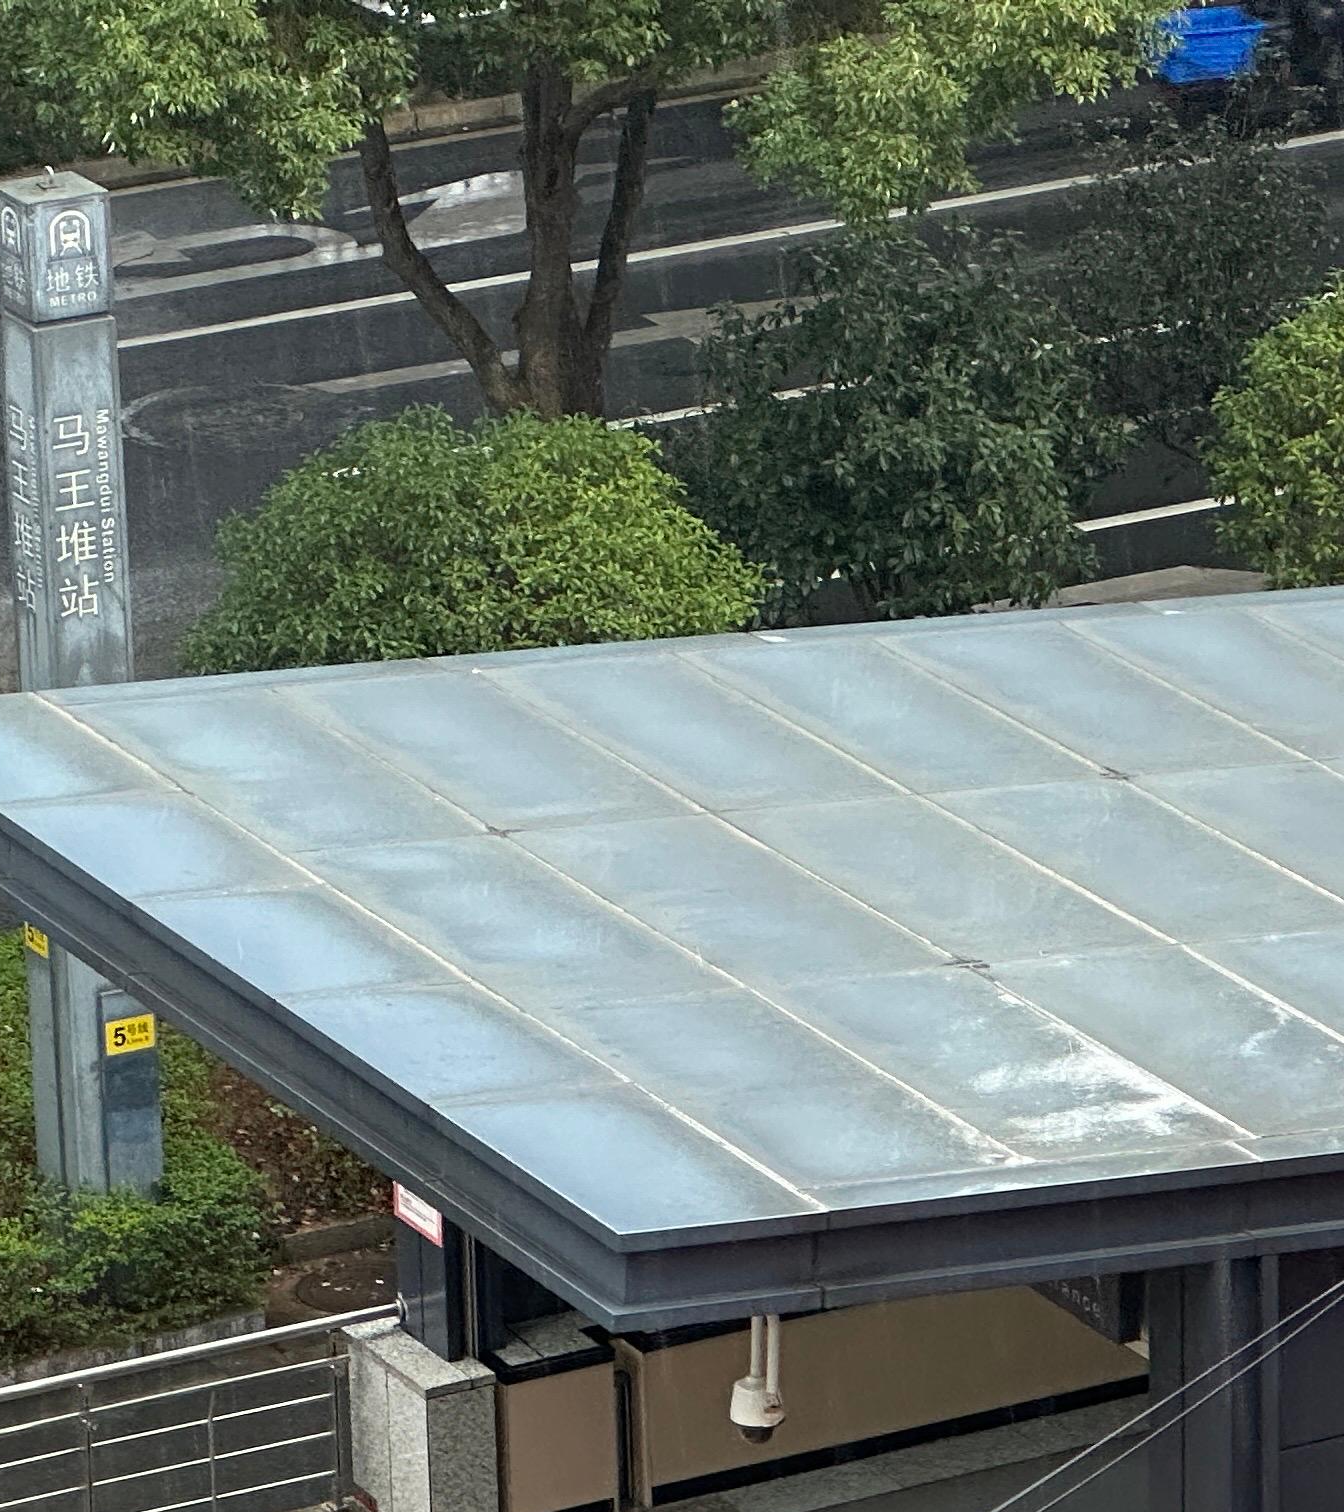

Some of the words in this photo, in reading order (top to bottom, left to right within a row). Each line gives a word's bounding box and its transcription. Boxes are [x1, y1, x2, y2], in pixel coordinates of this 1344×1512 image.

[46, 262, 99, 292] 地铁
[50, 291, 97, 307] METRO
[96, 409, 113, 513] Mawangdui
[53, 414, 99, 617] 马王堆站
[101, 517, 115, 583] Station
